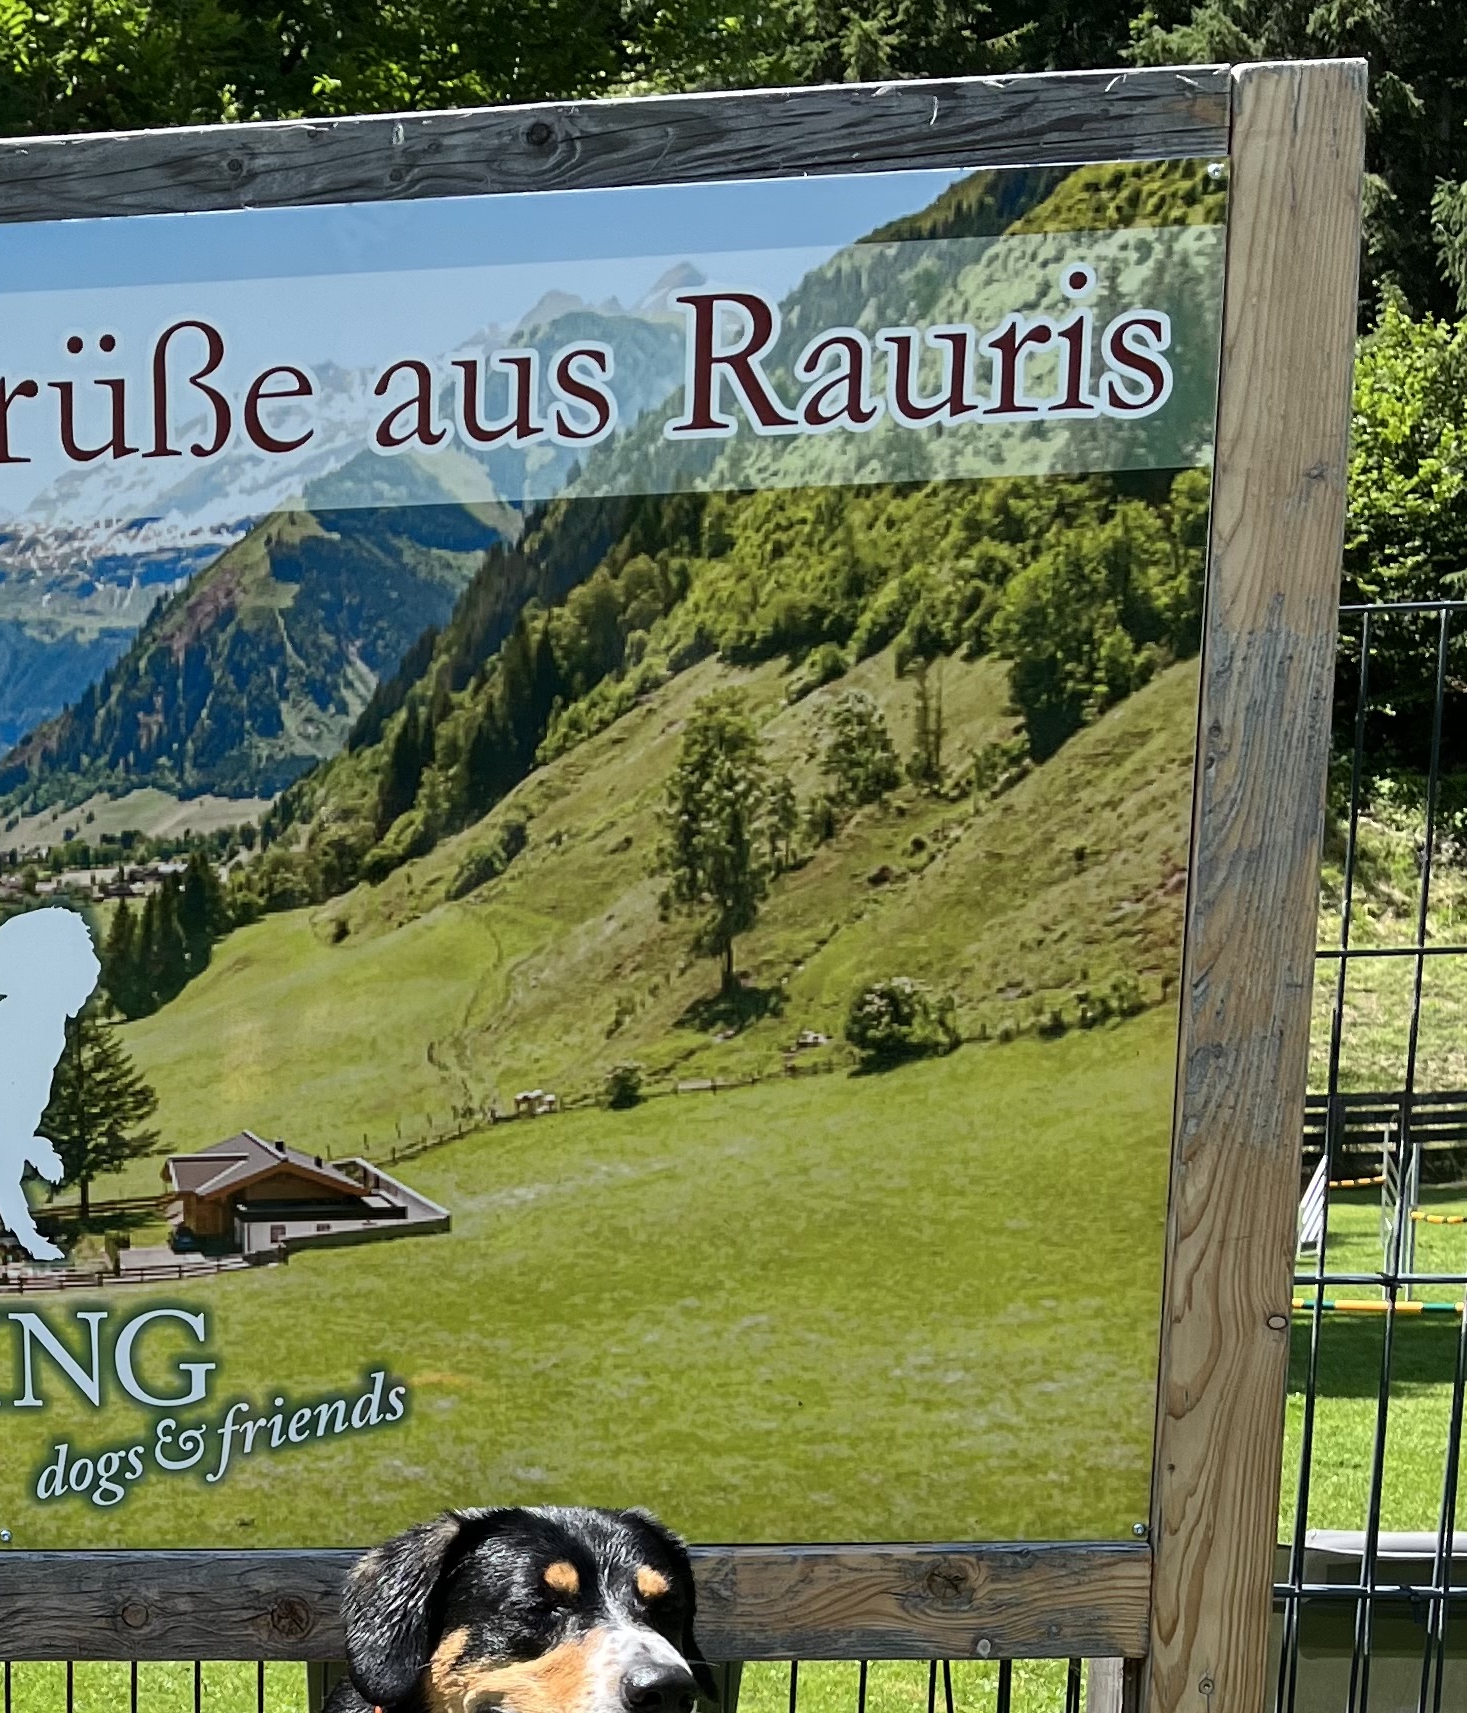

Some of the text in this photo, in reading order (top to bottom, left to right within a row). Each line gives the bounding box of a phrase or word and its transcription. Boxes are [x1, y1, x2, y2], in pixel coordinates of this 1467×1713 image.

[374, 343, 614, 446] aus
[670, 269, 1168, 433] Rauris
[36, 1372, 407, 1508] dogs & friends
